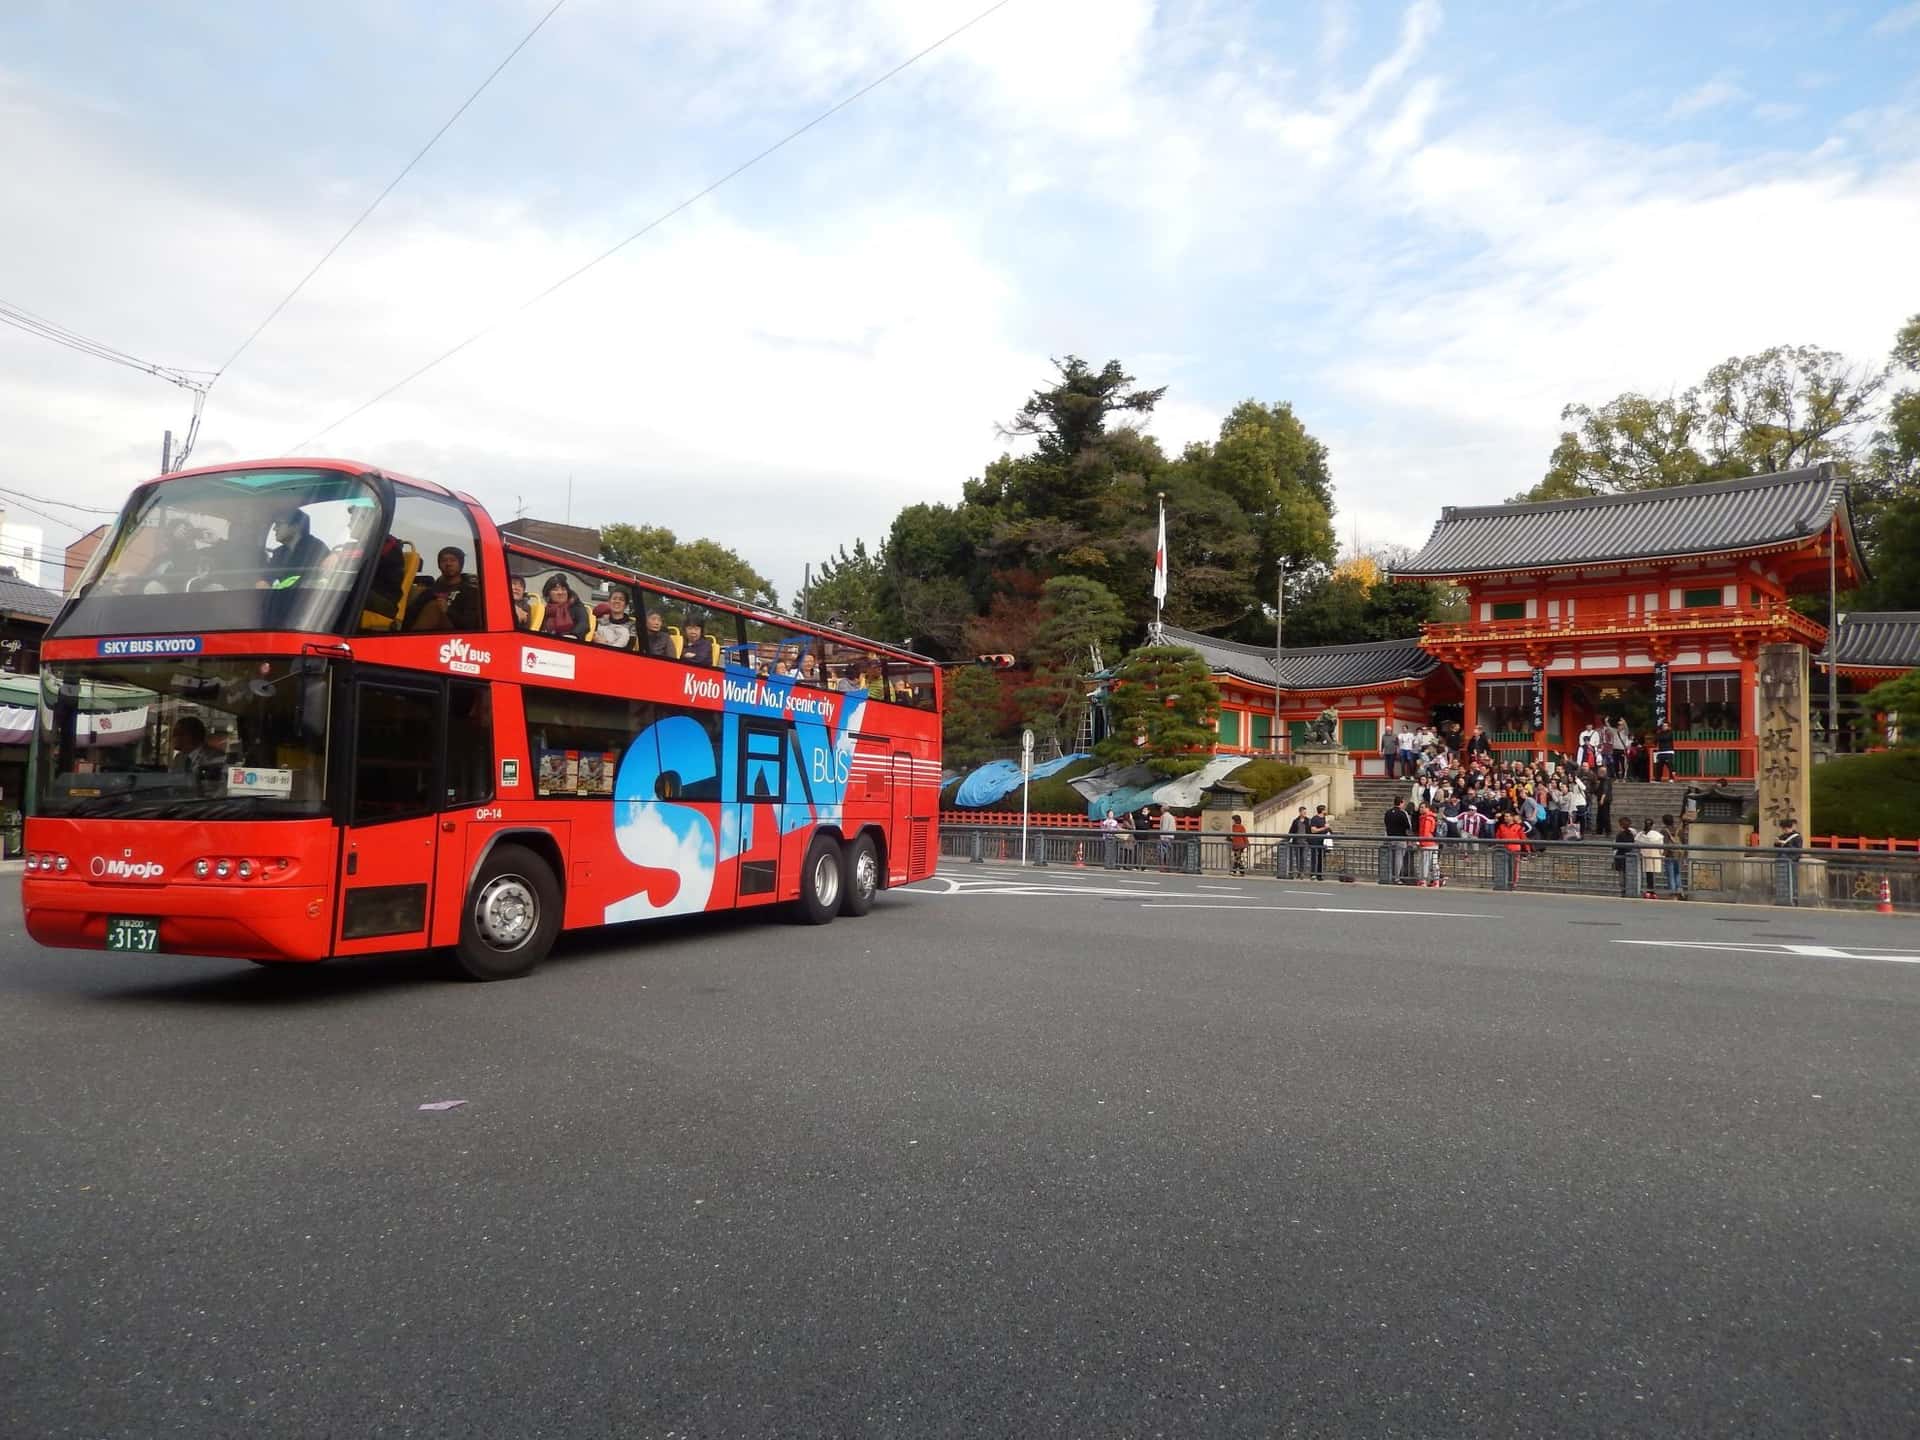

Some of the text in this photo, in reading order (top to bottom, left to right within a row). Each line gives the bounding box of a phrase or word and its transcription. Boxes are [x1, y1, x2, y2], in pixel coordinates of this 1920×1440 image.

[104, 639, 196, 654] SKY BUS KYOTO
[440, 638, 491, 664] SKY BUS
[683, 672, 835, 722] Kyoto World No.1 scenic city
[813, 747, 848, 784] BUS
[1763, 705, 1800, 829] 八坂神社
[476, 807, 502, 820] OP-14
[107, 860, 164, 878] Myojo
